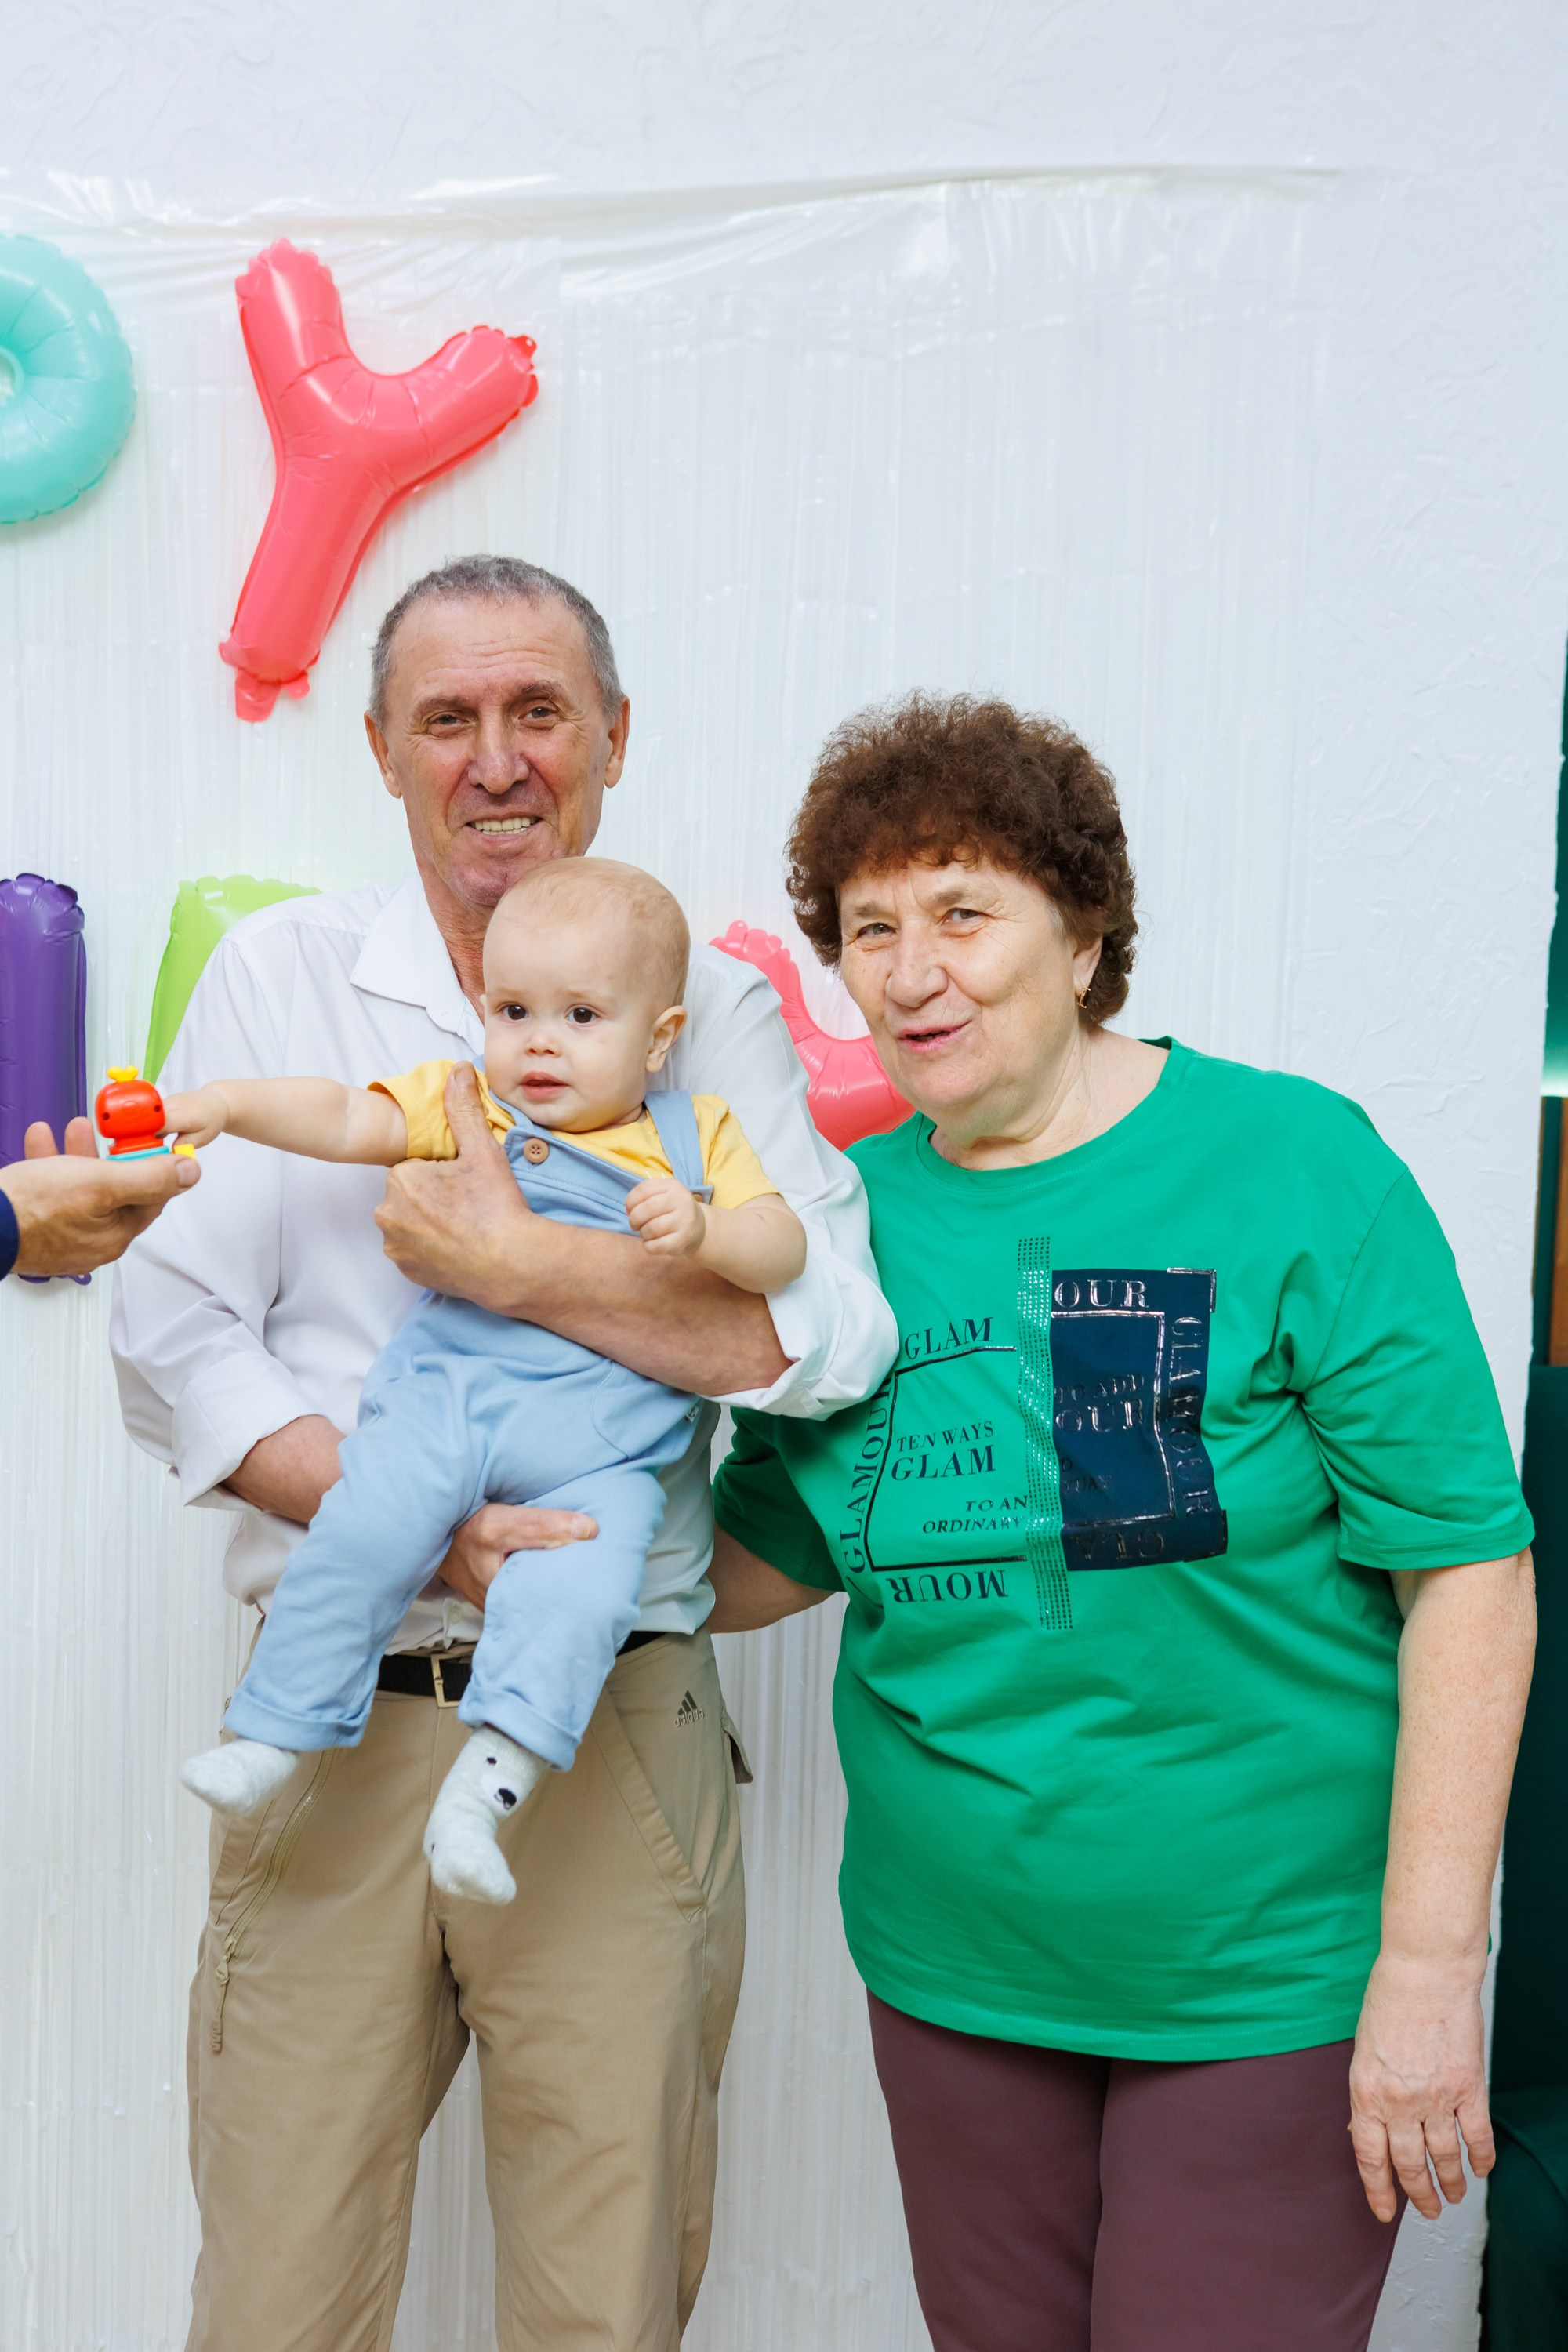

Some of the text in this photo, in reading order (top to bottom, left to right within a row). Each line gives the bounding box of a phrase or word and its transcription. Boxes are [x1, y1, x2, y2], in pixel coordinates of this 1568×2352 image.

[904, 1279, 1149, 1359] GLAM OUR
[891, 1398, 1145, 1481] GLAM OUR
[896, 1432, 937, 1452] TEN
[941, 1421, 993, 1446] WAYS
[965, 1499, 993, 1512] TO
[998, 1495, 1028, 1511] AN
[922, 1515, 1025, 1534] ORDINARY
[886, 1570, 1009, 1604] MOUR
[674, 1708, 705, 1728] adidas
